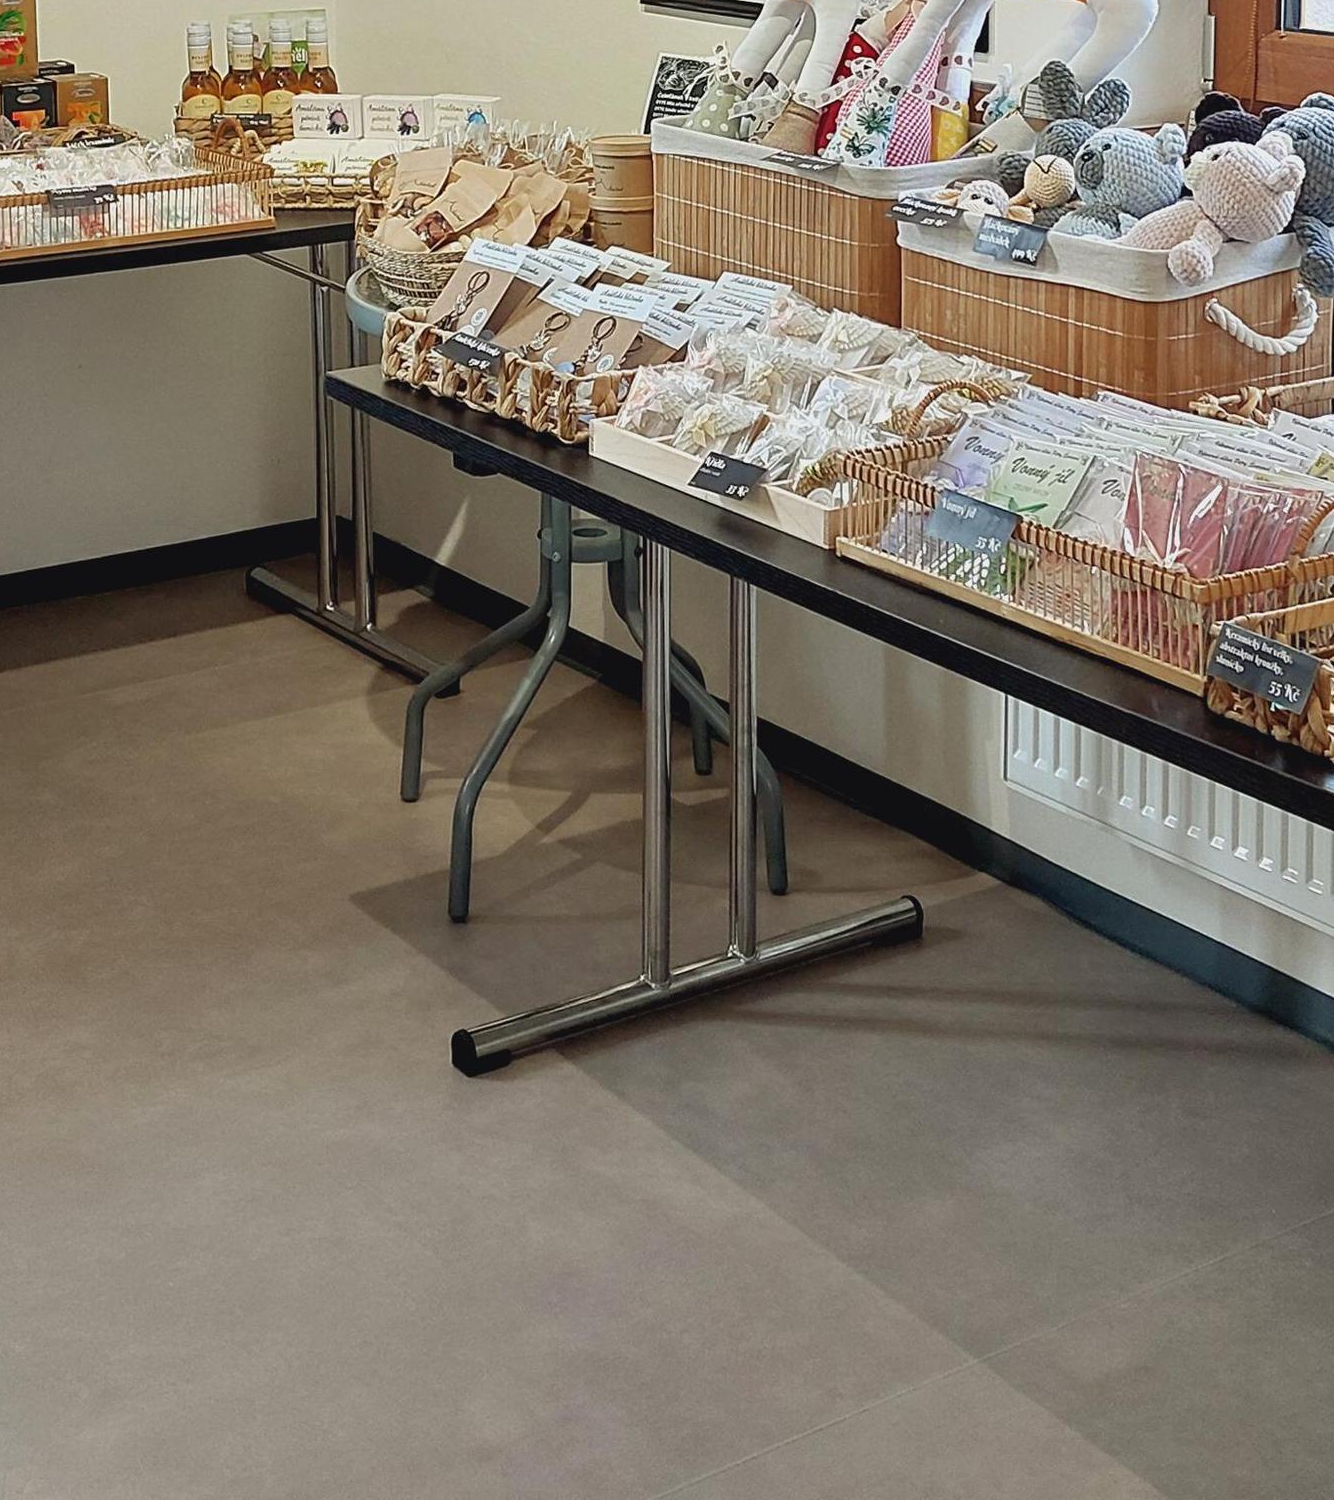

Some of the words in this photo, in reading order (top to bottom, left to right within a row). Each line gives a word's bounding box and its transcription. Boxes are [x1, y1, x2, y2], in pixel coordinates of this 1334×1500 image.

[1012, 456, 1055, 484] Vonný
[1225, 627, 1261, 651] Keramický
[1261, 642, 1274, 654] list
[1268, 681, 1283, 697] 55
[1283, 683, 1301, 703] Kč
